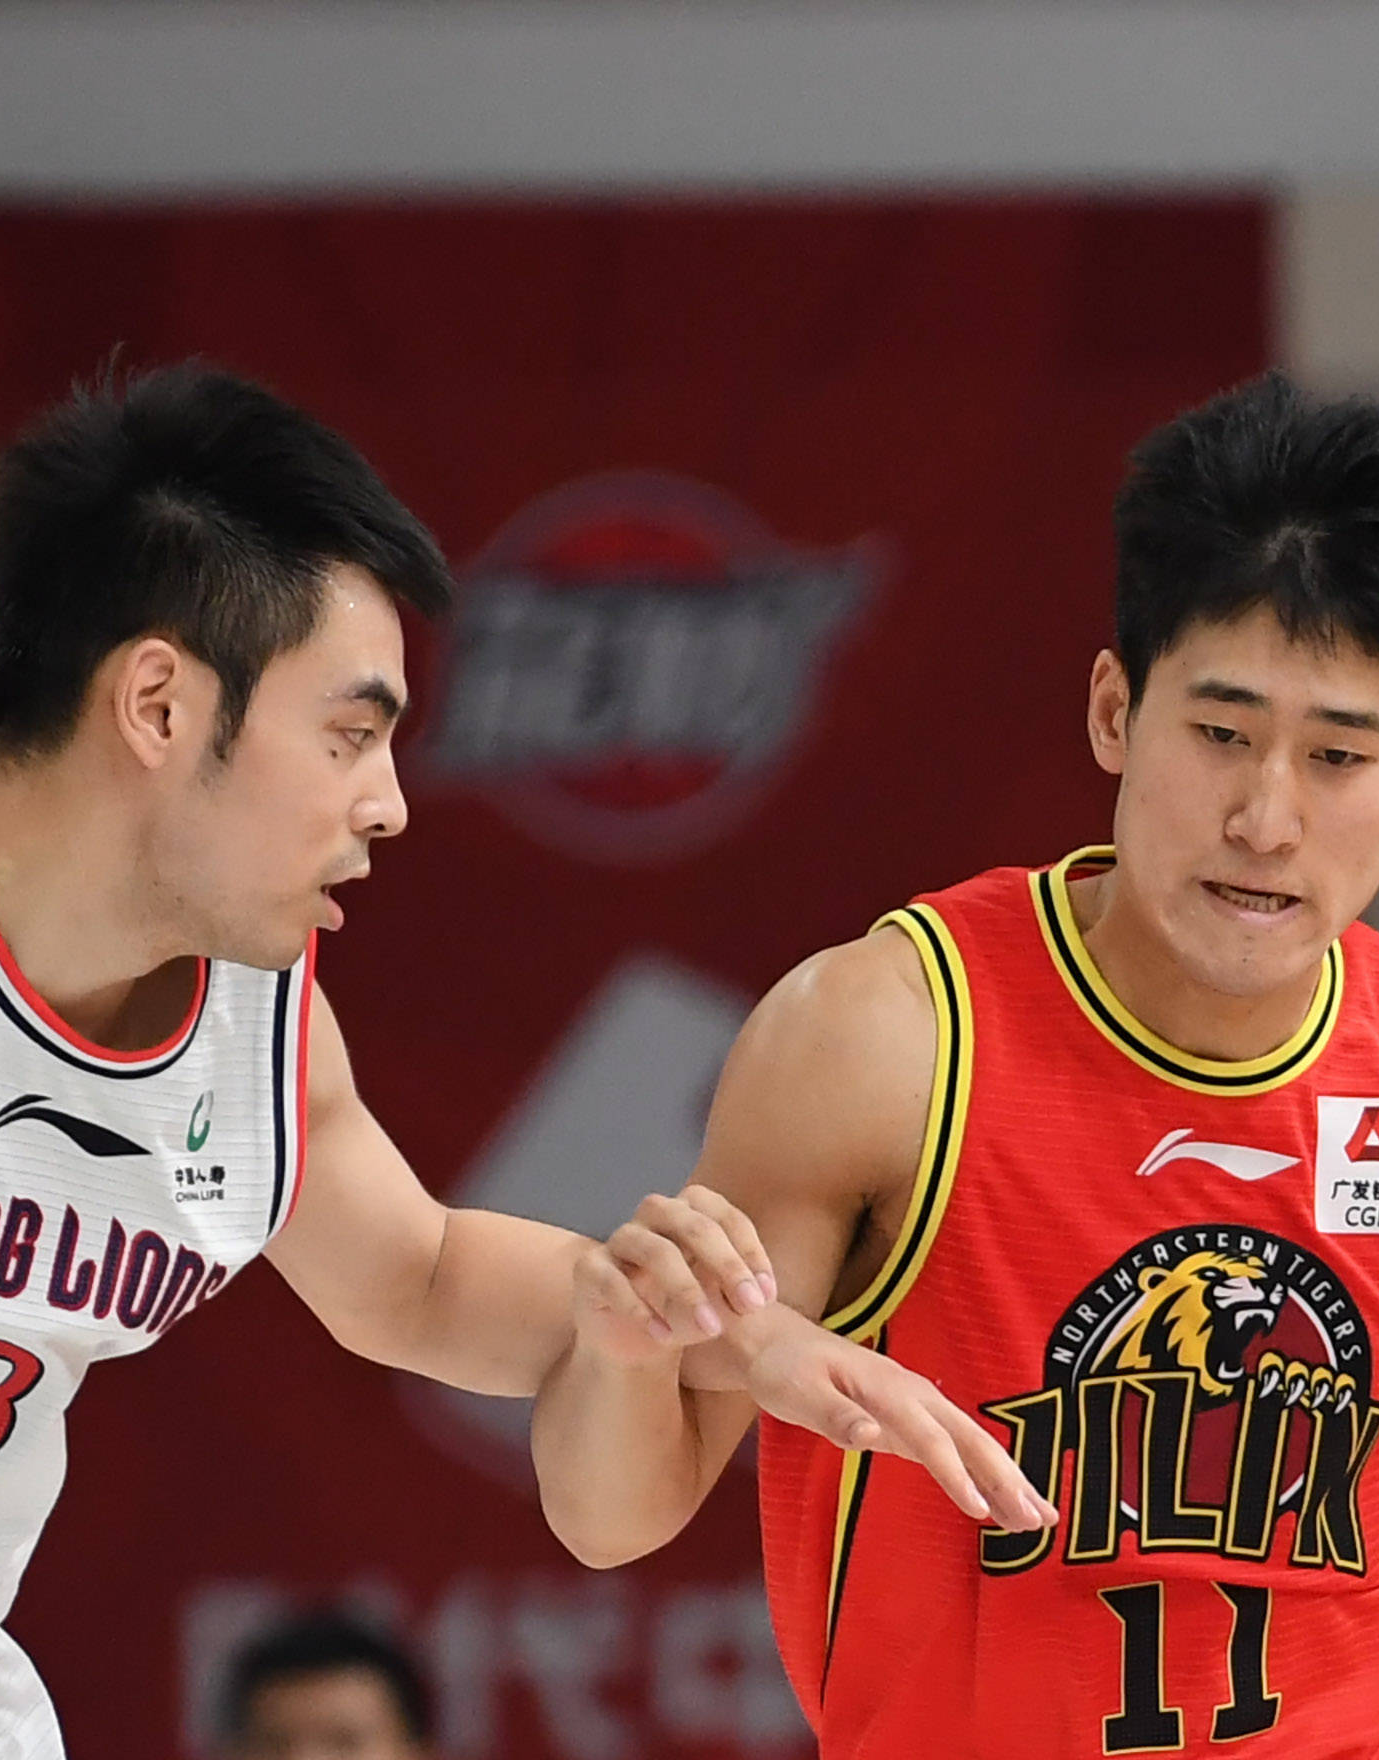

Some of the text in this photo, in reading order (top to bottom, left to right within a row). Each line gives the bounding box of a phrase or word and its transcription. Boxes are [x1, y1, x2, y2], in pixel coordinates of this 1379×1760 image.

[1052, 1232, 1363, 1364] NORTHEASTERN TIGERS
[1097, 1580, 1281, 1755] 11
